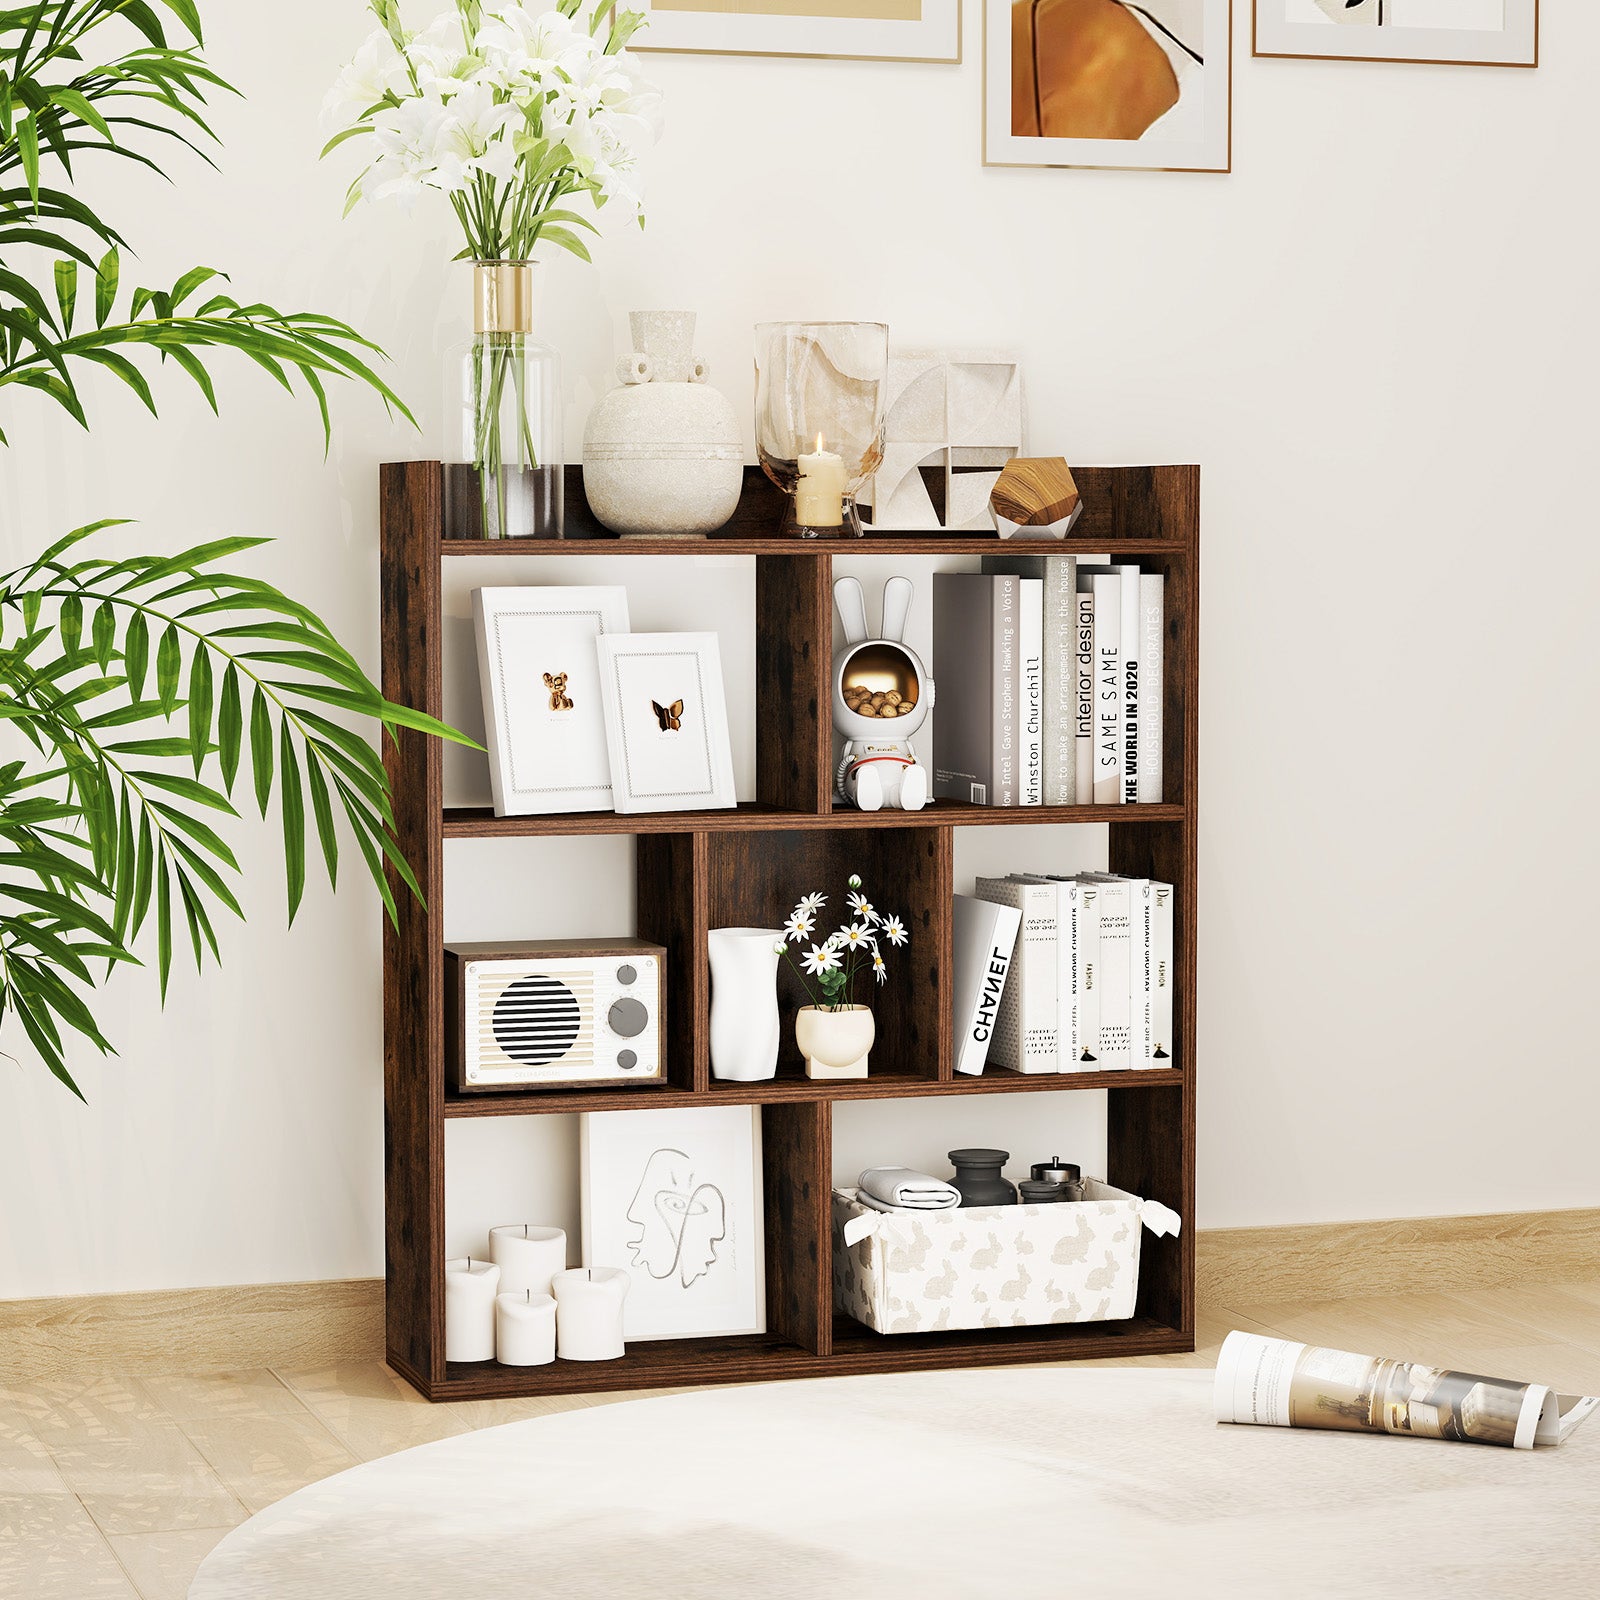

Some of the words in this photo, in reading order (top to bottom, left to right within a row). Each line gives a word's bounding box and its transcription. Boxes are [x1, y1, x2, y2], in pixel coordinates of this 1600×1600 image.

[1058, 561, 1069, 592] house
[1002, 580, 1012, 611] Voice
[1059, 599, 1069, 617] the
[1058, 624, 1069, 636] in
[1076, 600, 1094, 664] design
[1001, 629, 1014, 672] Hawking
[1147, 607, 1160, 686] DECORATES
[1059, 643, 1071, 710] arrangement
[1102, 648, 1118, 700] SAME
[1126, 661, 1138, 700] 2020
[1002, 677, 1013, 719] Stephen
[1027, 657, 1039, 733] Churchill
[1075, 671, 1092, 737] Interior
[1060, 717, 1068, 730] an
[1126, 704, 1138, 718] IN
[1002, 725, 1011, 750] Gave
[1058, 735, 1068, 761] make
[1101, 714, 1117, 766] SAME
[1125, 723, 1138, 775] WORLD
[1146, 696, 1159, 776] HOUSEHOLD
[1001, 756, 1012, 785] Intel
[1027, 743, 1039, 804] Winston
[1059, 767, 1068, 779] to
[1058, 785, 1068, 804] How
[1125, 779, 1137, 805] THE
[1083, 891, 1097, 908] Dior
[1156, 889, 1169, 907] Dior
[1158, 961, 1166, 987] FASHION
